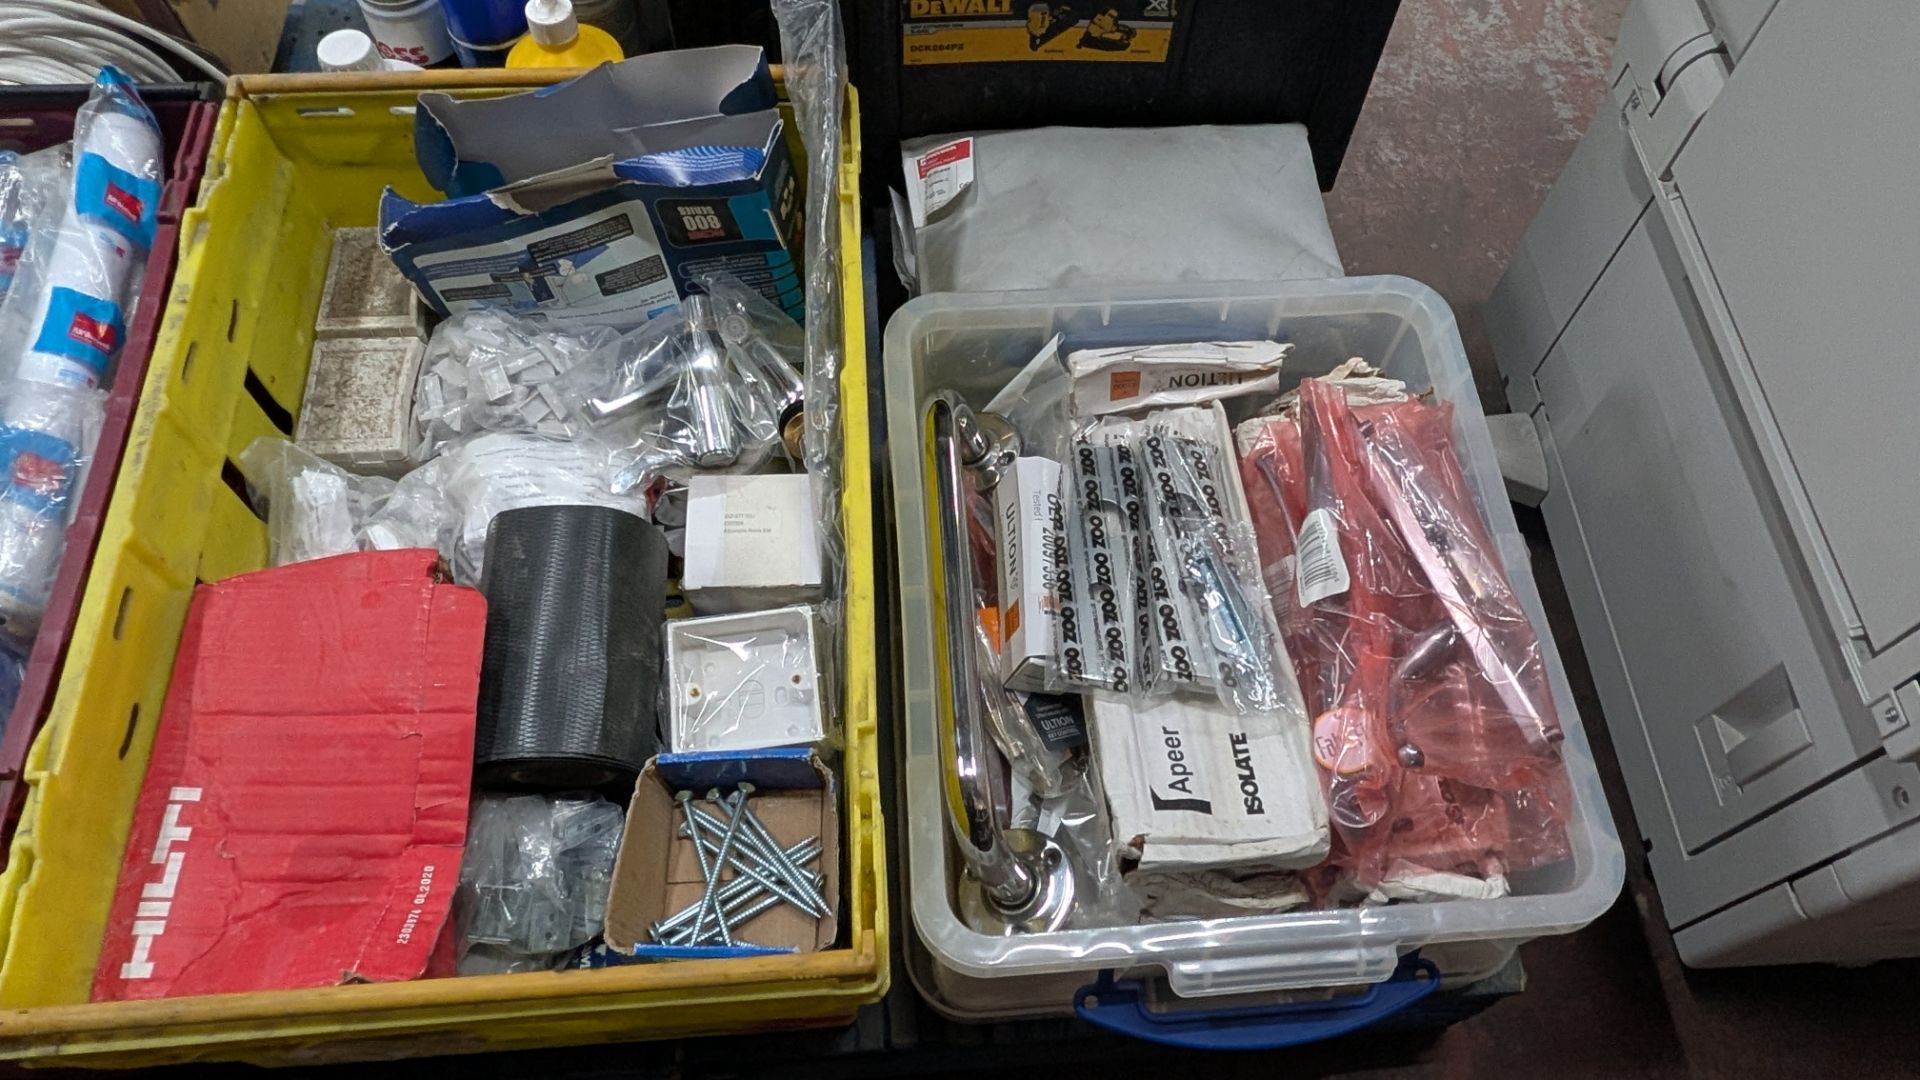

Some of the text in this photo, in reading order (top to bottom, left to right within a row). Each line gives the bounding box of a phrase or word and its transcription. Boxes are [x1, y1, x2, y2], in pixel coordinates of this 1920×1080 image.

[682, 215, 722, 231] 800
[1079, 448, 1096, 476] ZOO
[1146, 436, 1167, 468] ZOO
[1190, 450, 1211, 480] ZOO
[1084, 479, 1101, 512] ZOO
[1120, 467, 1138, 497] ZOO
[1157, 472, 1177, 502] ZOO
[1202, 484, 1223, 518] ZOO
[1005, 502, 1017, 576] ULTION
[1089, 515, 1106, 549] ZOO
[1094, 552, 1112, 585] ZOO
[1150, 567, 1169, 600] ZOO
[1056, 569, 1073, 602] ZOO
[1101, 589, 1119, 624] ZOO
[1158, 604, 1182, 640] ZOO
[1060, 606, 1078, 644] ZOO
[1106, 627, 1125, 662] ZOO
[1170, 646, 1193, 681] ZOO
[1041, 715, 1074, 731] ULTION
[1161, 726, 1194, 794] Apeer
[1229, 732, 1265, 815] ISOLATE
[120, 787, 202, 979] HILTI
